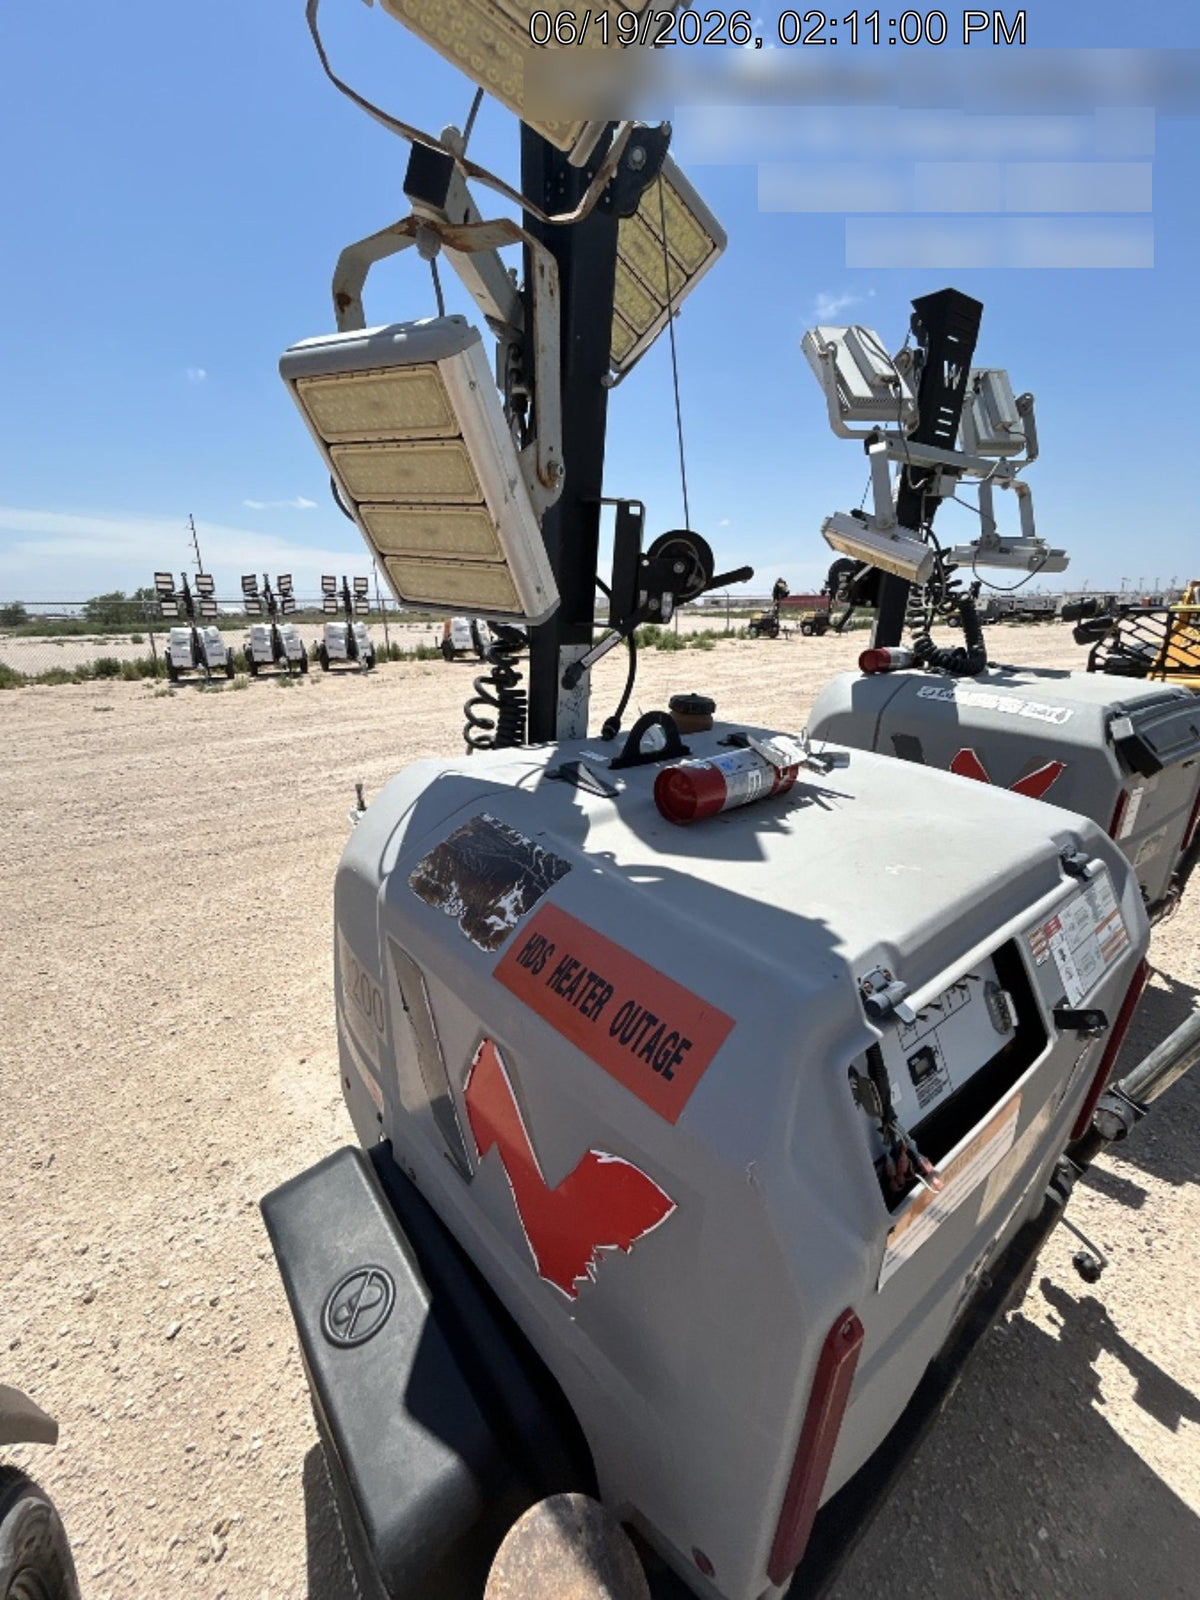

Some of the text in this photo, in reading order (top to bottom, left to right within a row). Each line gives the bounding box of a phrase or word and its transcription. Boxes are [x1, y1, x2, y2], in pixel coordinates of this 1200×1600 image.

[516, 932, 693, 1082] HDS HEATER OUTAGE
